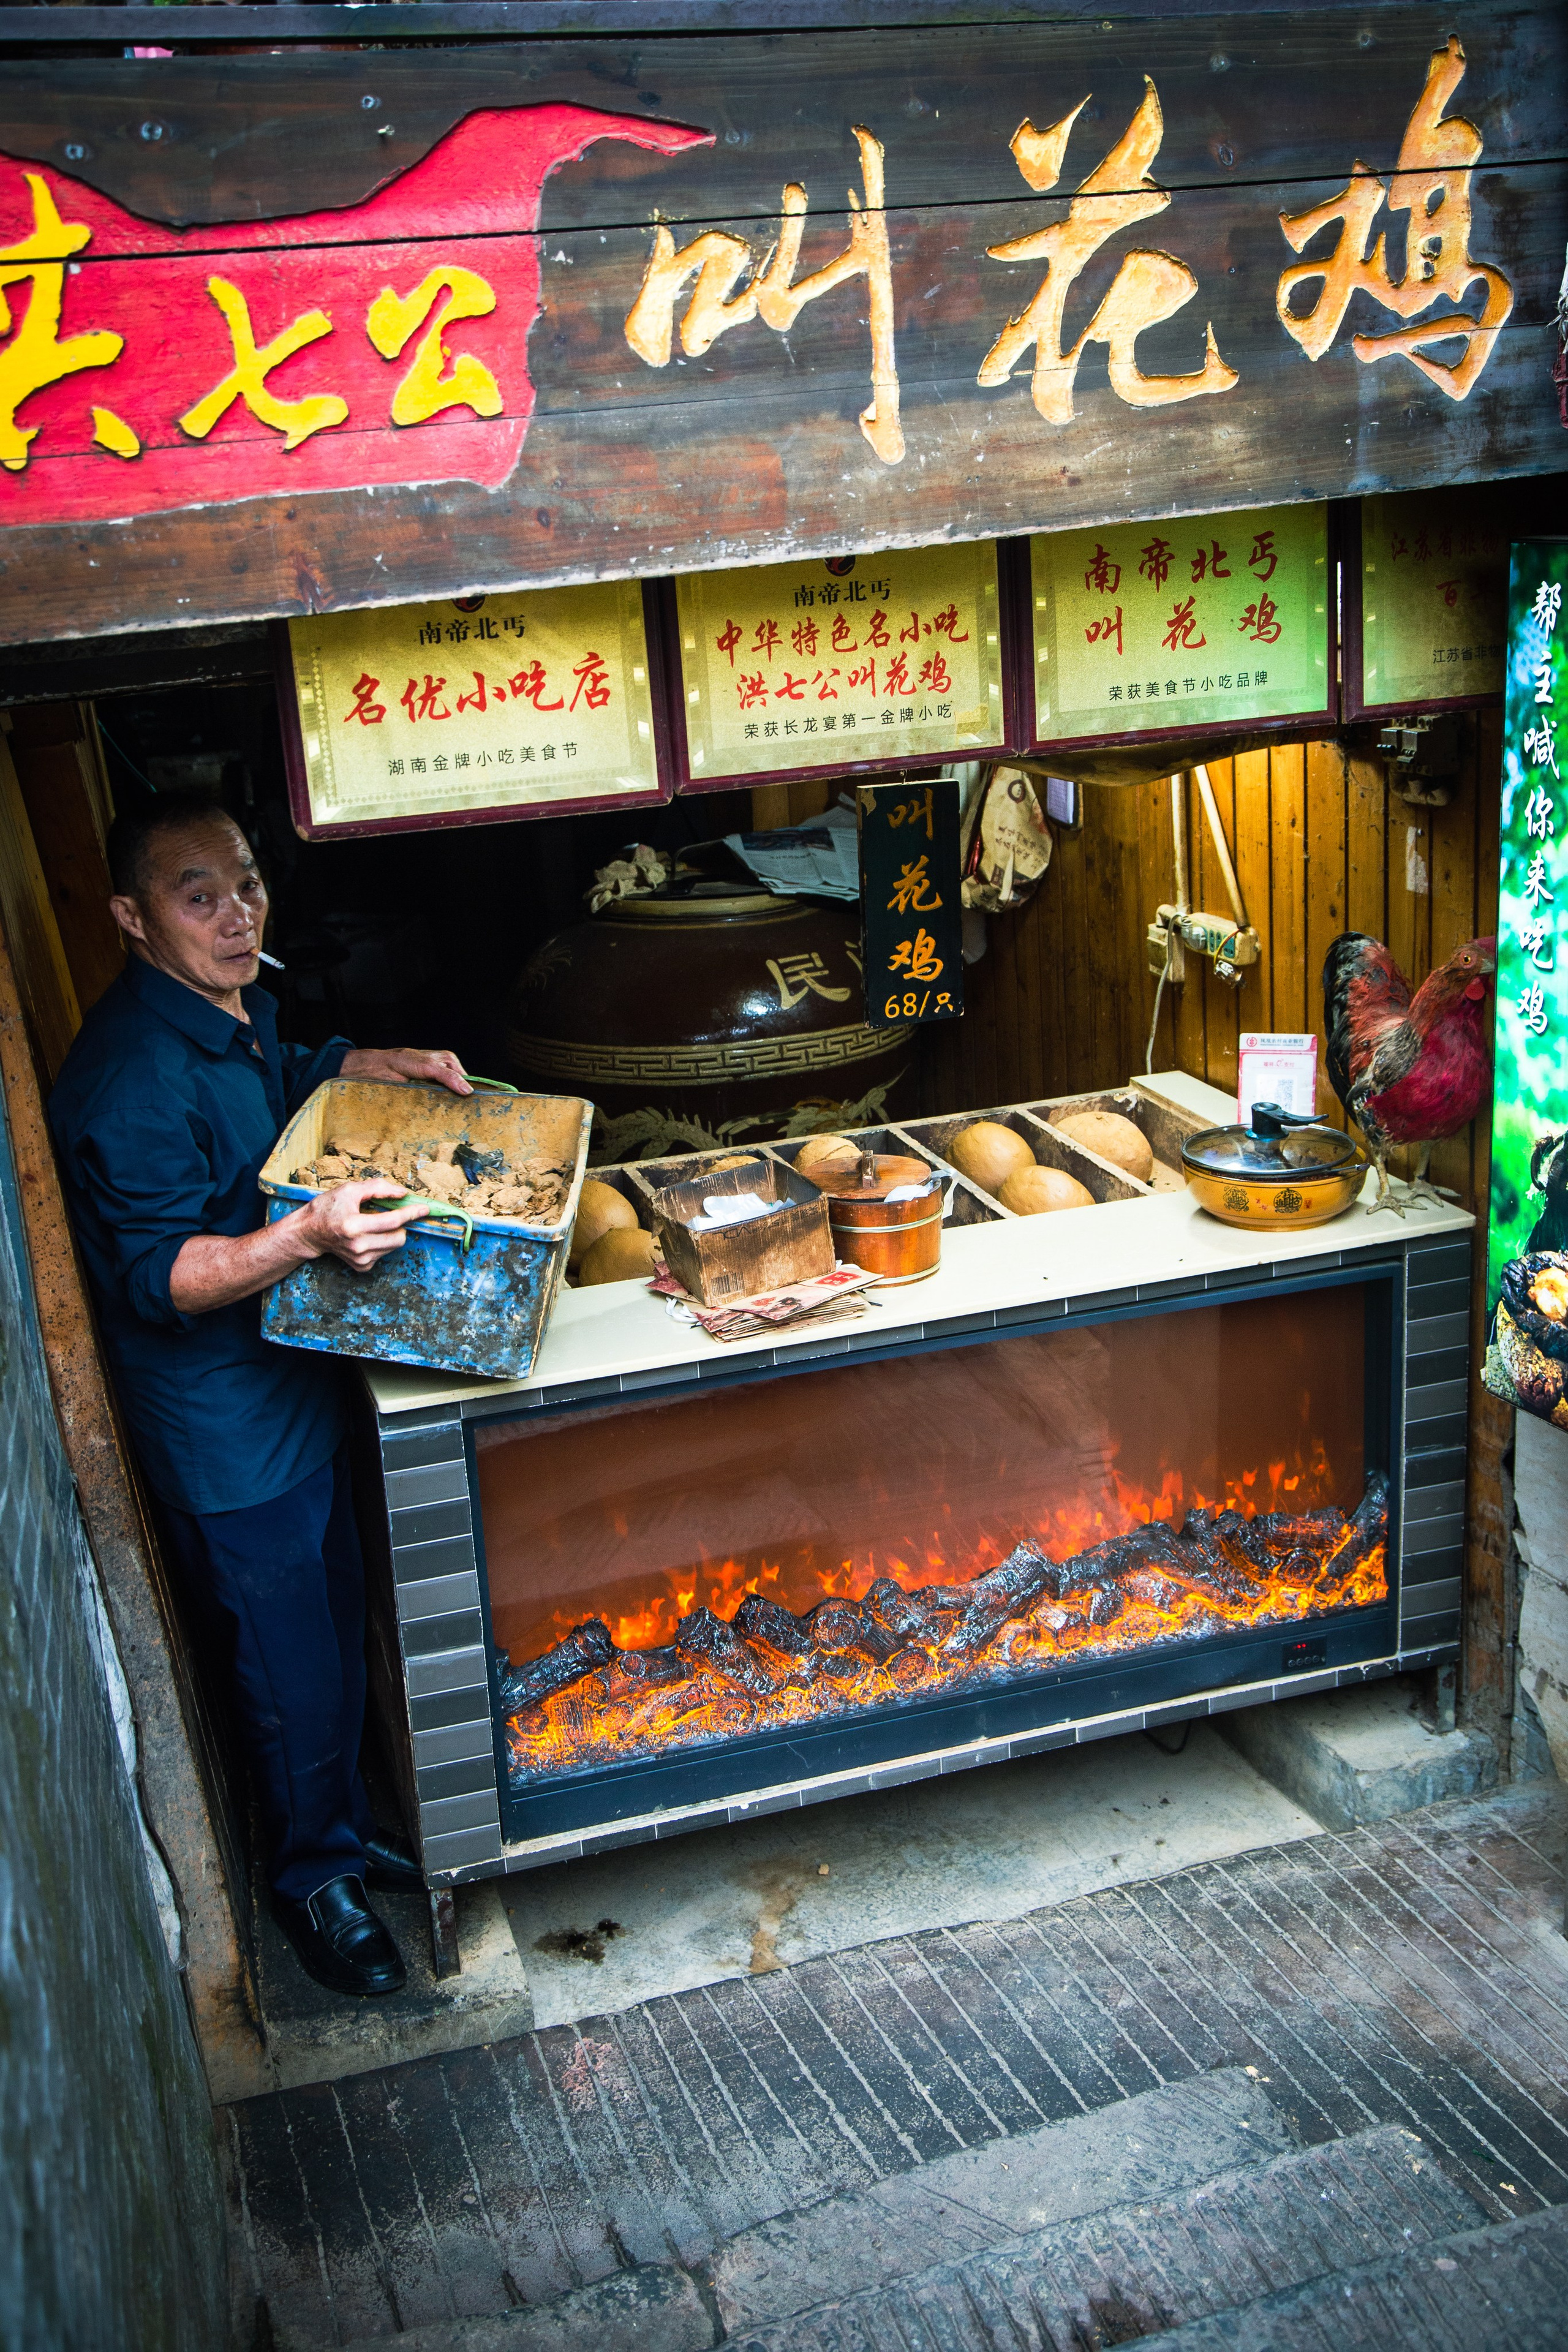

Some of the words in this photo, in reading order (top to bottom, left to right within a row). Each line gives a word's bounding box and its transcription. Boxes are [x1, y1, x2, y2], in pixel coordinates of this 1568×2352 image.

[1084, 531, 1278, 594] 南帝北丐
[792, 578, 891, 608] 南帝北丐
[417, 614, 526, 646] 南帝北丐
[716, 604, 969, 668] 中华特色名小吃
[1085, 593, 1282, 655] 叫花鸡
[737, 651, 952, 710] 洪七公叫花鸡
[1433, 644, 1506, 664] 江苏省非物
[344, 651, 611, 726] 名优小吃店
[1109, 670, 1268, 701] 荣获美食节小吃品牌
[744, 704, 952, 739] 荣获长龙宴第一金牌小吃
[388, 742, 579, 776] 湖南金牌小吃美食节
[1515, 580, 1562, 1035] 帮主喊你来吃鸡
[887, 788, 944, 982] 叫花鸡
[766, 940, 862, 1010] 民
[884, 990, 954, 1019] 68/只
